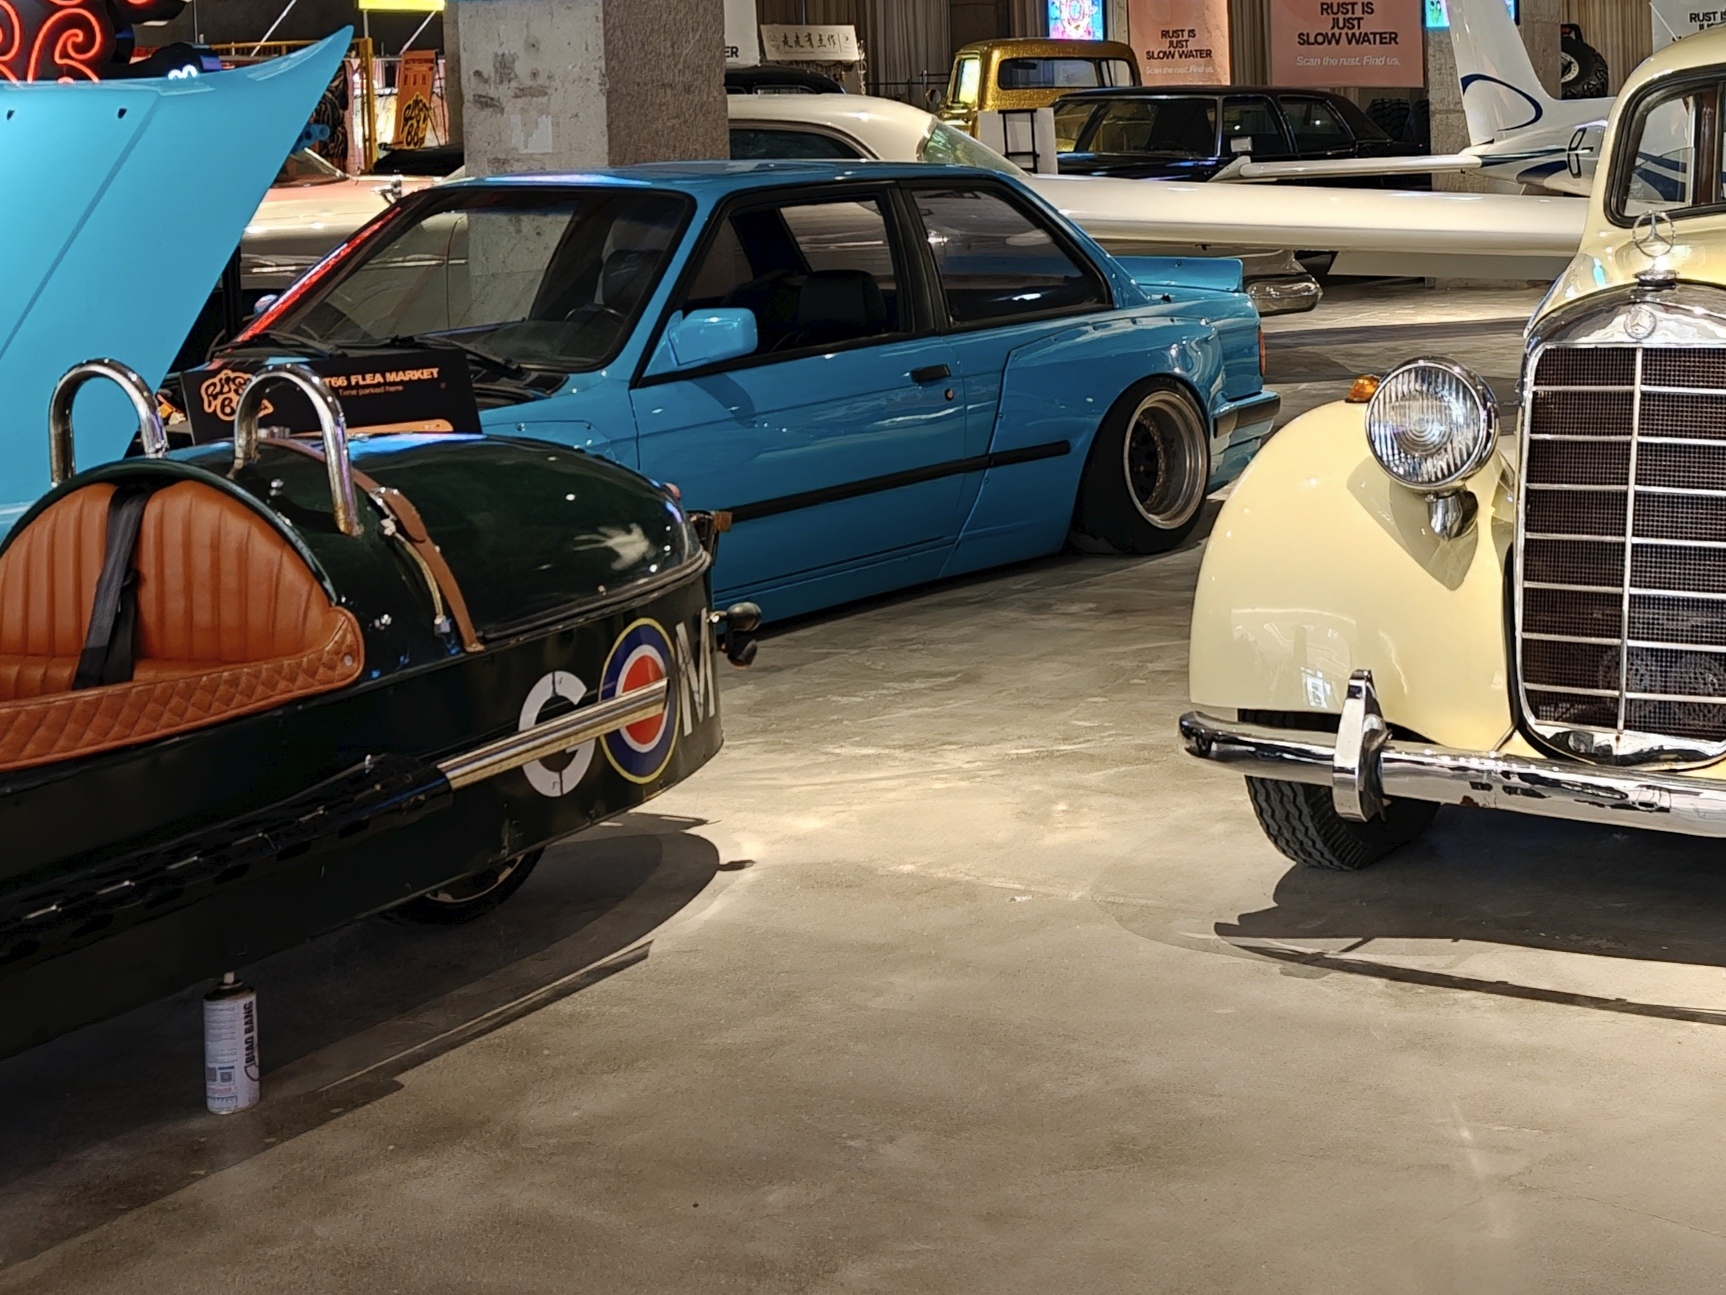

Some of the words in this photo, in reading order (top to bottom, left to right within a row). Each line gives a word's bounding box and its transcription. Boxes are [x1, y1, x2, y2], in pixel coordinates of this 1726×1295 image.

[1320, 2, 1358, 16] RUST
[1361, 1, 1374, 15] IS
[1690, 11, 1718, 23] RUST
[1331, 17, 1364, 30] JUST
[1161, 29, 1185, 39] RUST
[1188, 29, 1196, 38] IS
[1297, 32, 1343, 46] SLOW
[1346, 31, 1399, 46] WATER
[1168, 40, 1189, 49] JUST
[1146, 50, 1176, 60] SLOW
[1178, 49, 1212, 59] WATER
[351, 372, 384, 385] FLEA
[386, 367, 439, 382] MARKET
